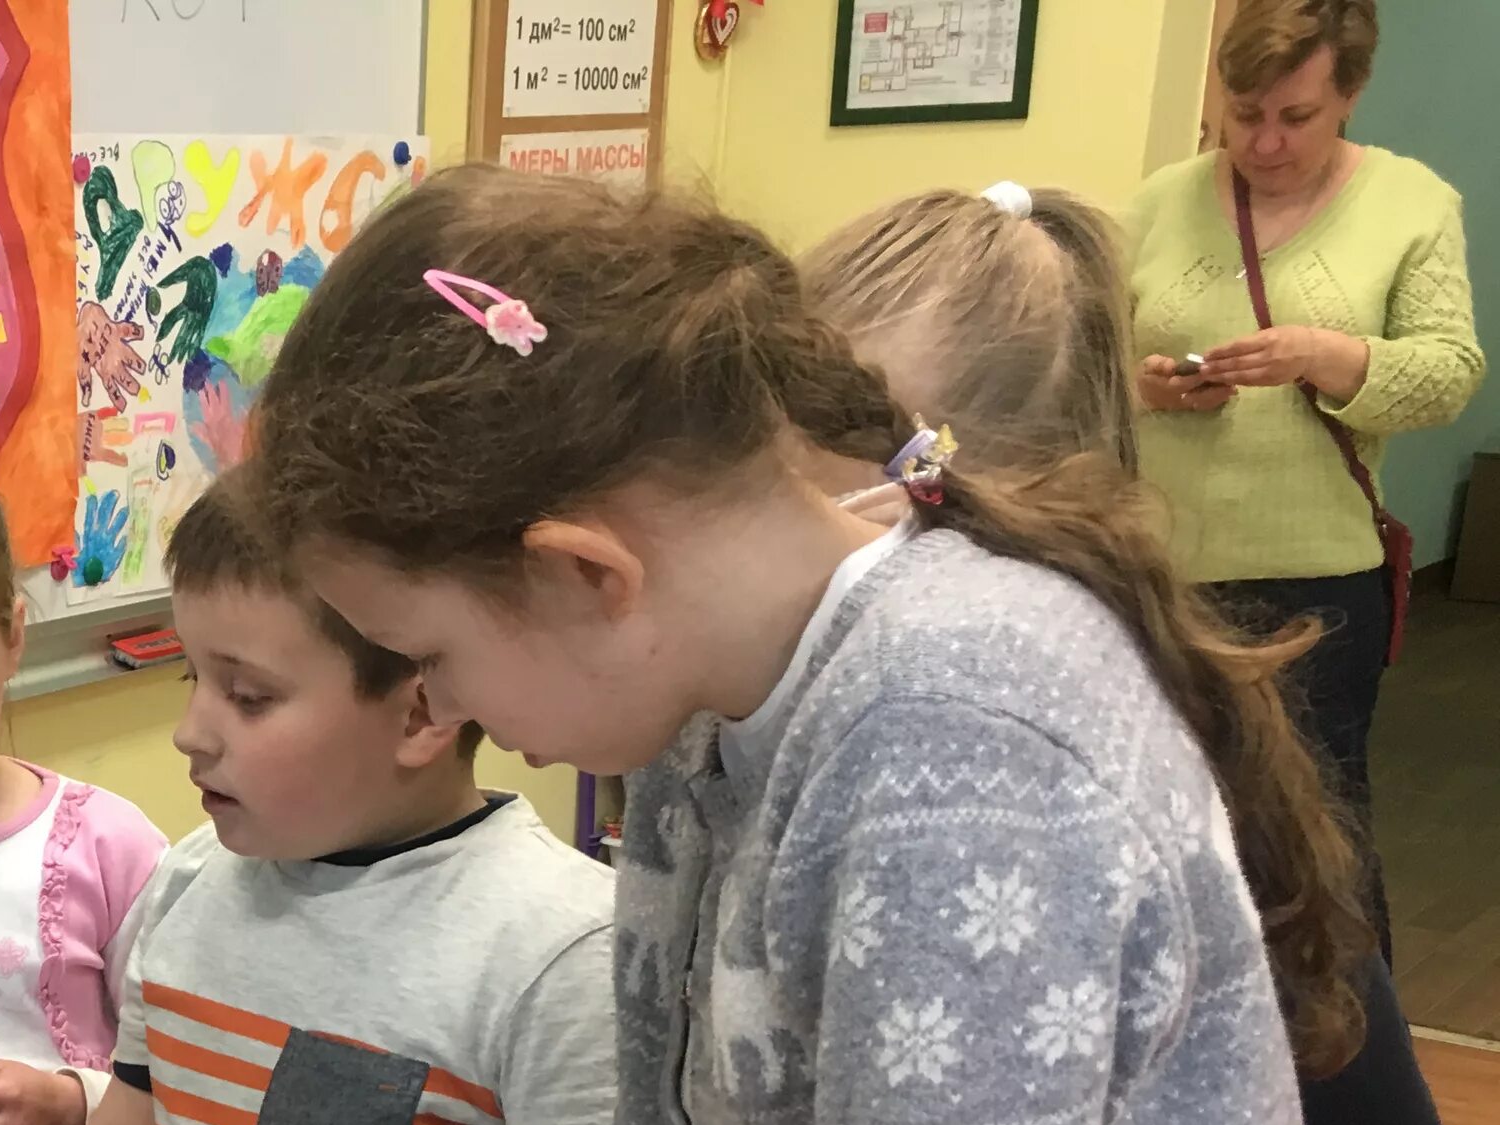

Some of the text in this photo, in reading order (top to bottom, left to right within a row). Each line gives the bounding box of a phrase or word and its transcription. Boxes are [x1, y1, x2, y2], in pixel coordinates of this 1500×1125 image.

[516, 16, 523, 40] 1
[578, 18, 604, 41] 100
[513, 66, 520, 90] 1
[574, 66, 618, 90] 10000
[510, 143, 645, 174] МЕРЫ МАССЫ
